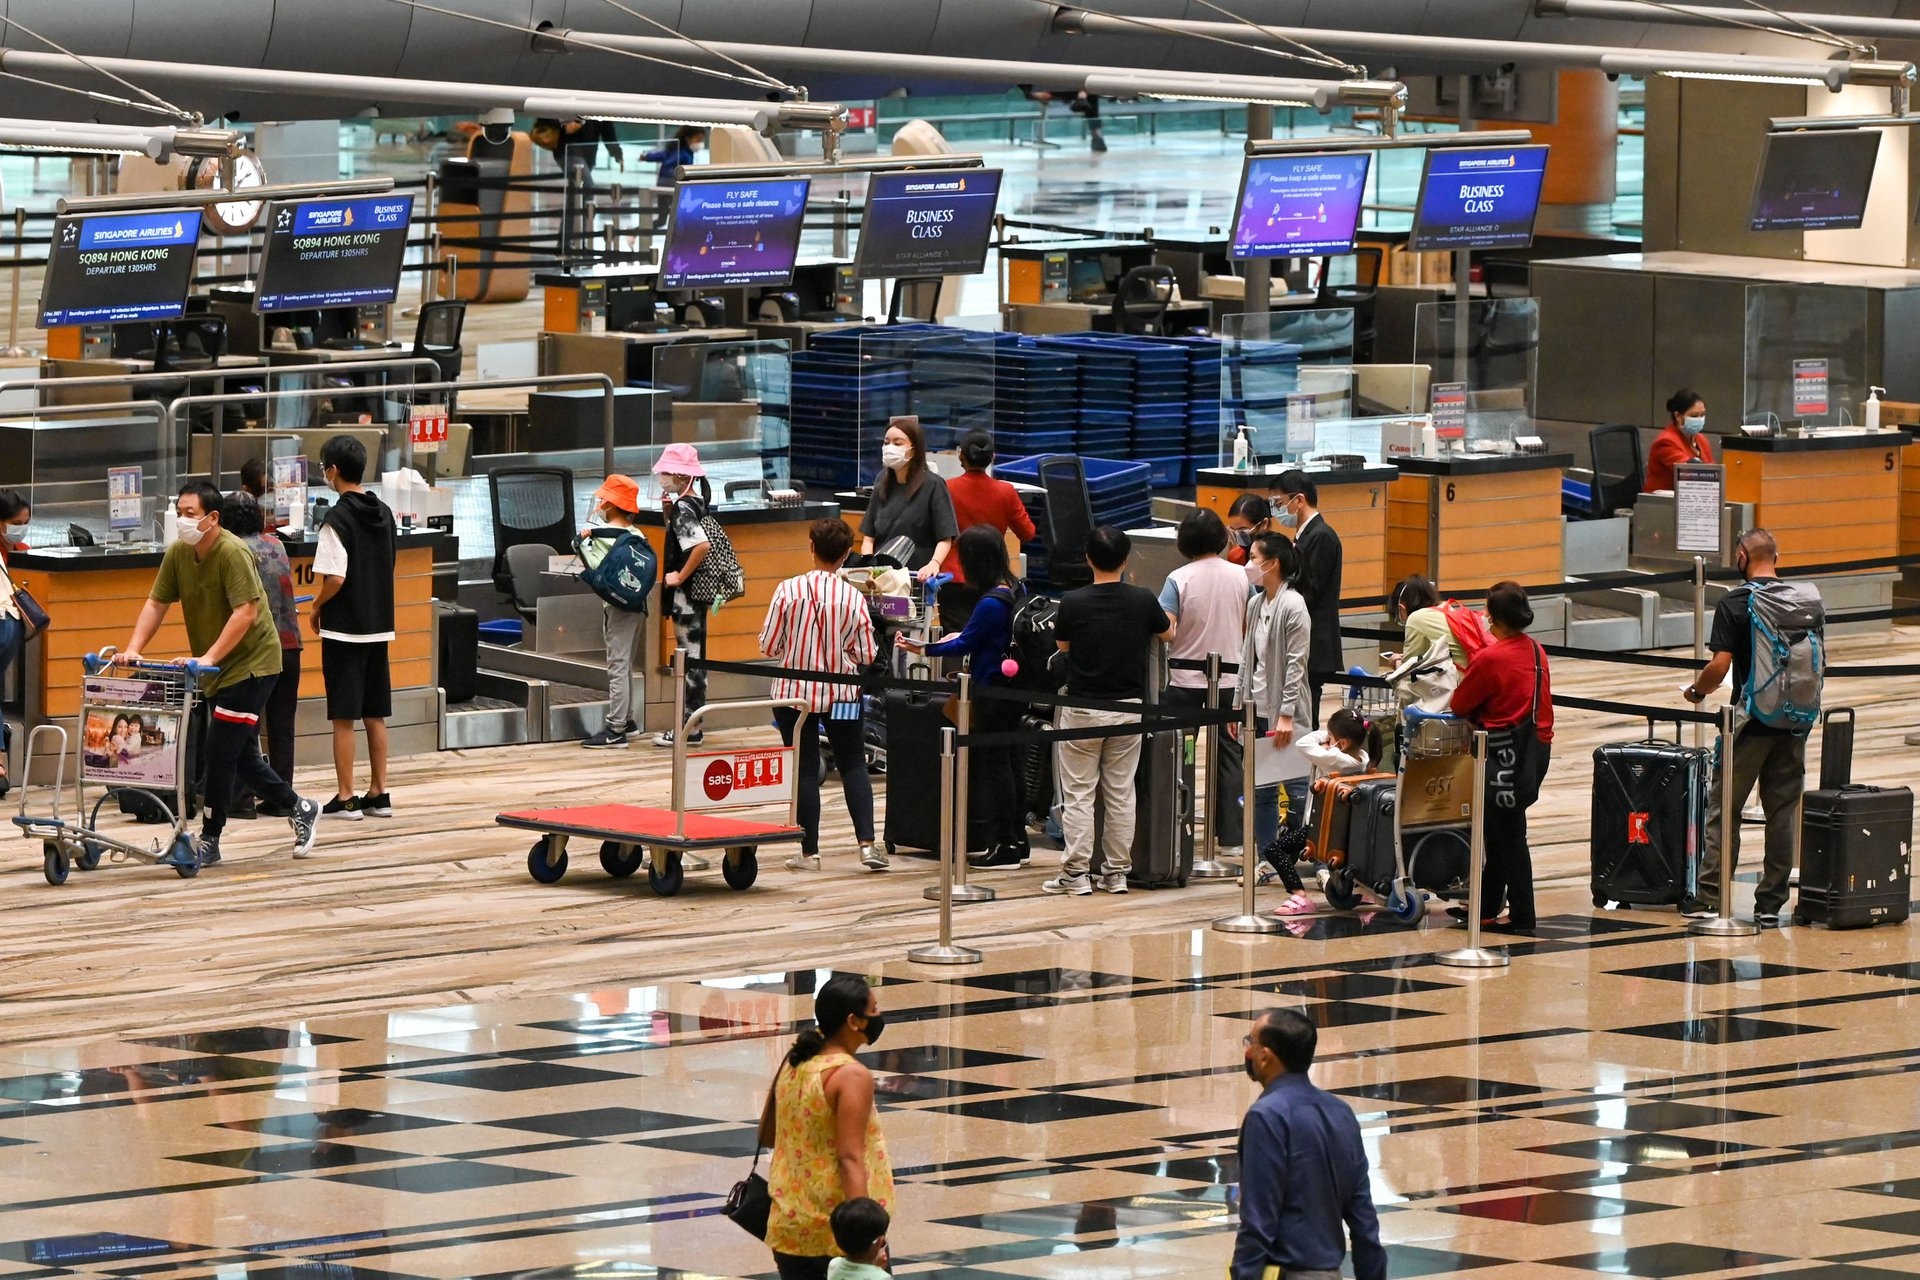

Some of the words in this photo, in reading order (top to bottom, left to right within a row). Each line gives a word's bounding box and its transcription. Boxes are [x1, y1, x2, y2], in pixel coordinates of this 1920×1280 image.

[1305, 164, 1323, 172] SAFE
[726, 191, 739, 199] FLY
[740, 190, 759, 198] SAFE
[1460, 184, 1505, 199] BUSINESS
[374, 205, 403, 214] BUSINESS
[722, 201, 737, 209] keep
[742, 200, 755, 208] safe
[1464, 199, 1495, 213] CLASS
[308, 210, 342, 219] SINGAPORE
[315, 216, 342, 224] AIRLINES
[377, 213, 397, 222] CLASS
[906, 209, 954, 224] BUSINESS
[94, 229, 138, 240] SINGAPORE
[139, 227, 173, 237] AIRLINES
[911, 225, 943, 239] CLASS
[1449, 226, 1465, 234] STAR
[293, 237, 322, 250] SQ894
[323, 235, 351, 247] HONG
[353, 233, 380, 245] KONG
[78, 252, 108, 265] SQ894
[110, 250, 139, 263] HONG
[140, 248, 169, 260] KONG
[300, 250, 339, 260] DEPARTURE
[340, 248, 369, 257] 1305HRS
[86, 265, 126, 276] DEPARTURE
[128, 263, 157, 273] 1305HRS
[1886, 452, 1894, 471] 5
[1369, 487, 1379, 508] 7
[1446, 482, 1456, 502] 6
[294, 563, 316, 585] 10
[708, 774, 732, 786] sats
[1425, 776, 1455, 799] GST
